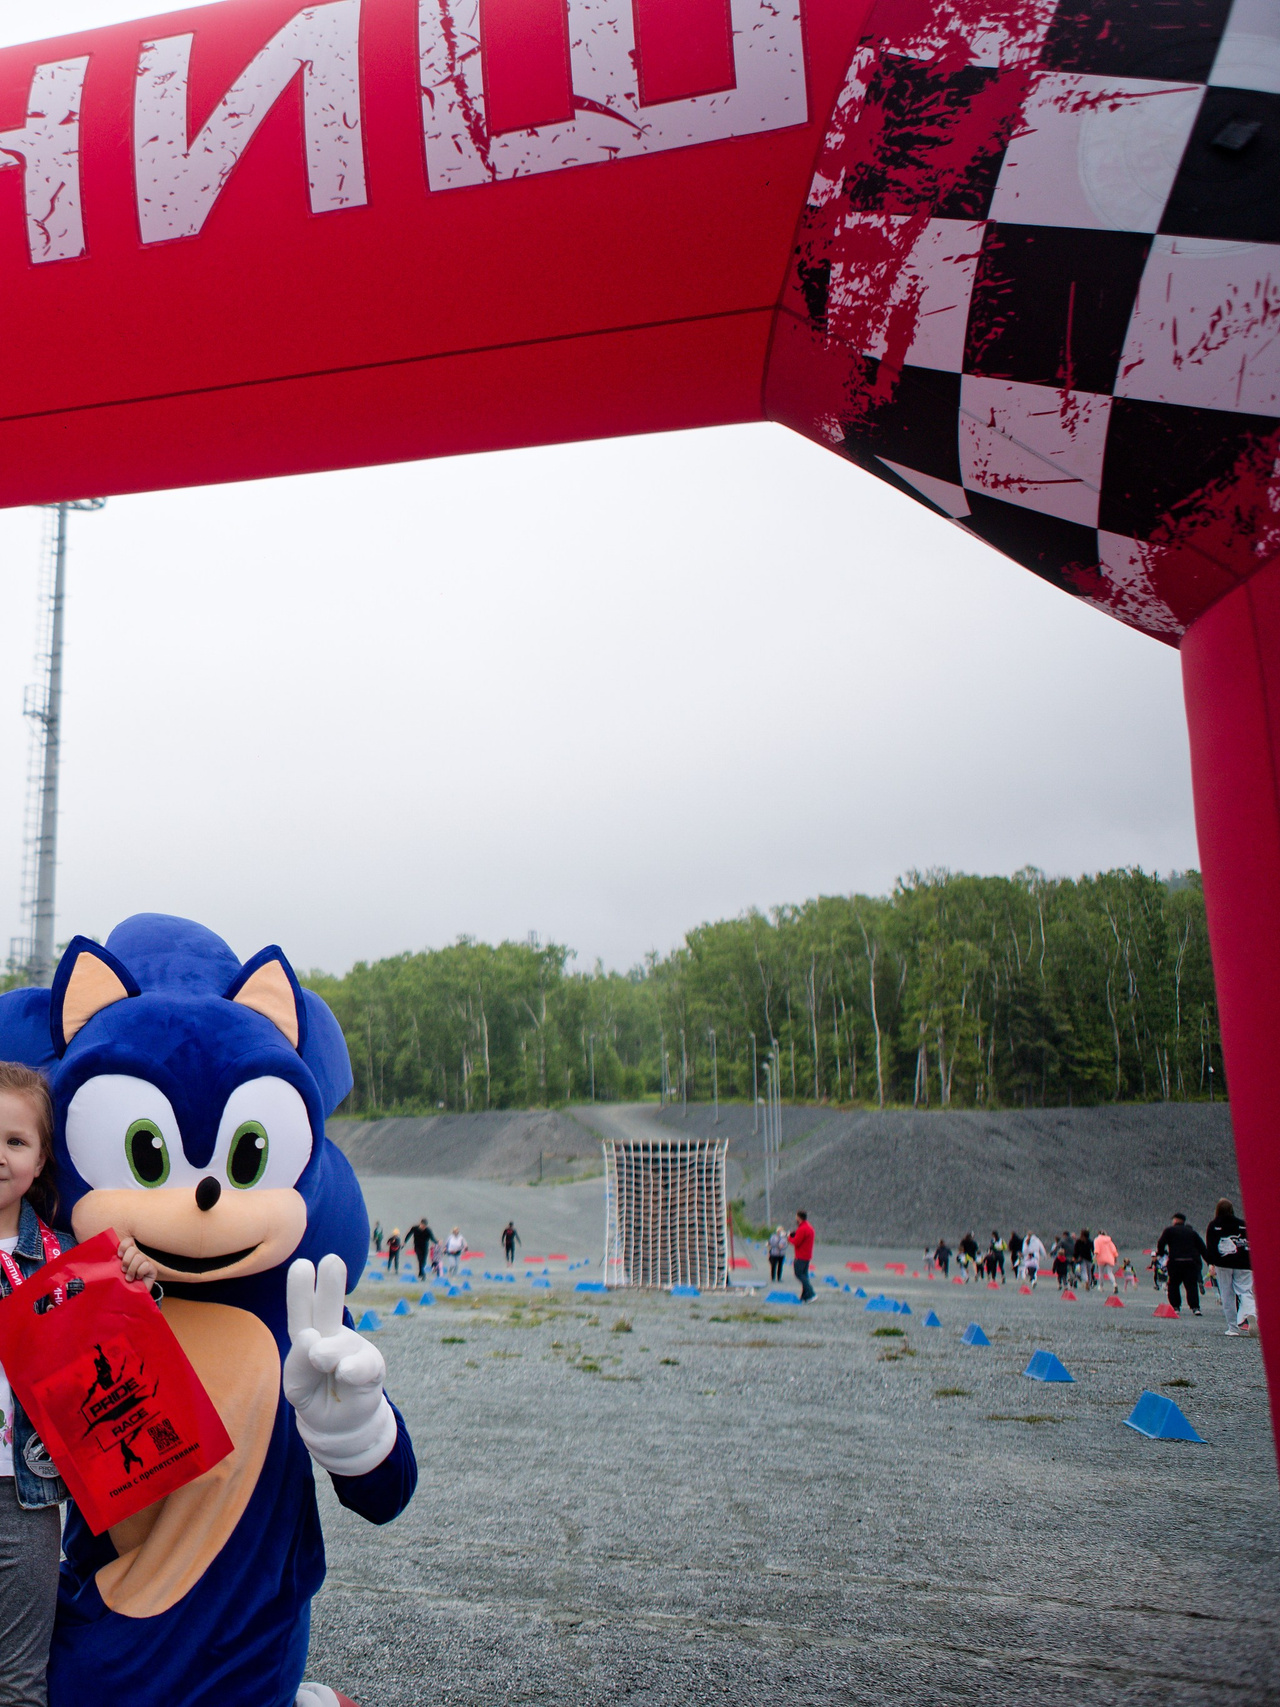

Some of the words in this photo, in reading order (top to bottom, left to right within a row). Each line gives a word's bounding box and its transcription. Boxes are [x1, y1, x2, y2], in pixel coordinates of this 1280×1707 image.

[89, 1377, 140, 1418] PRIDE
[111, 1407, 149, 1437] RACE
[109, 1482, 133, 1498] гонка
[139, 1443, 200, 1480] препятствиями
